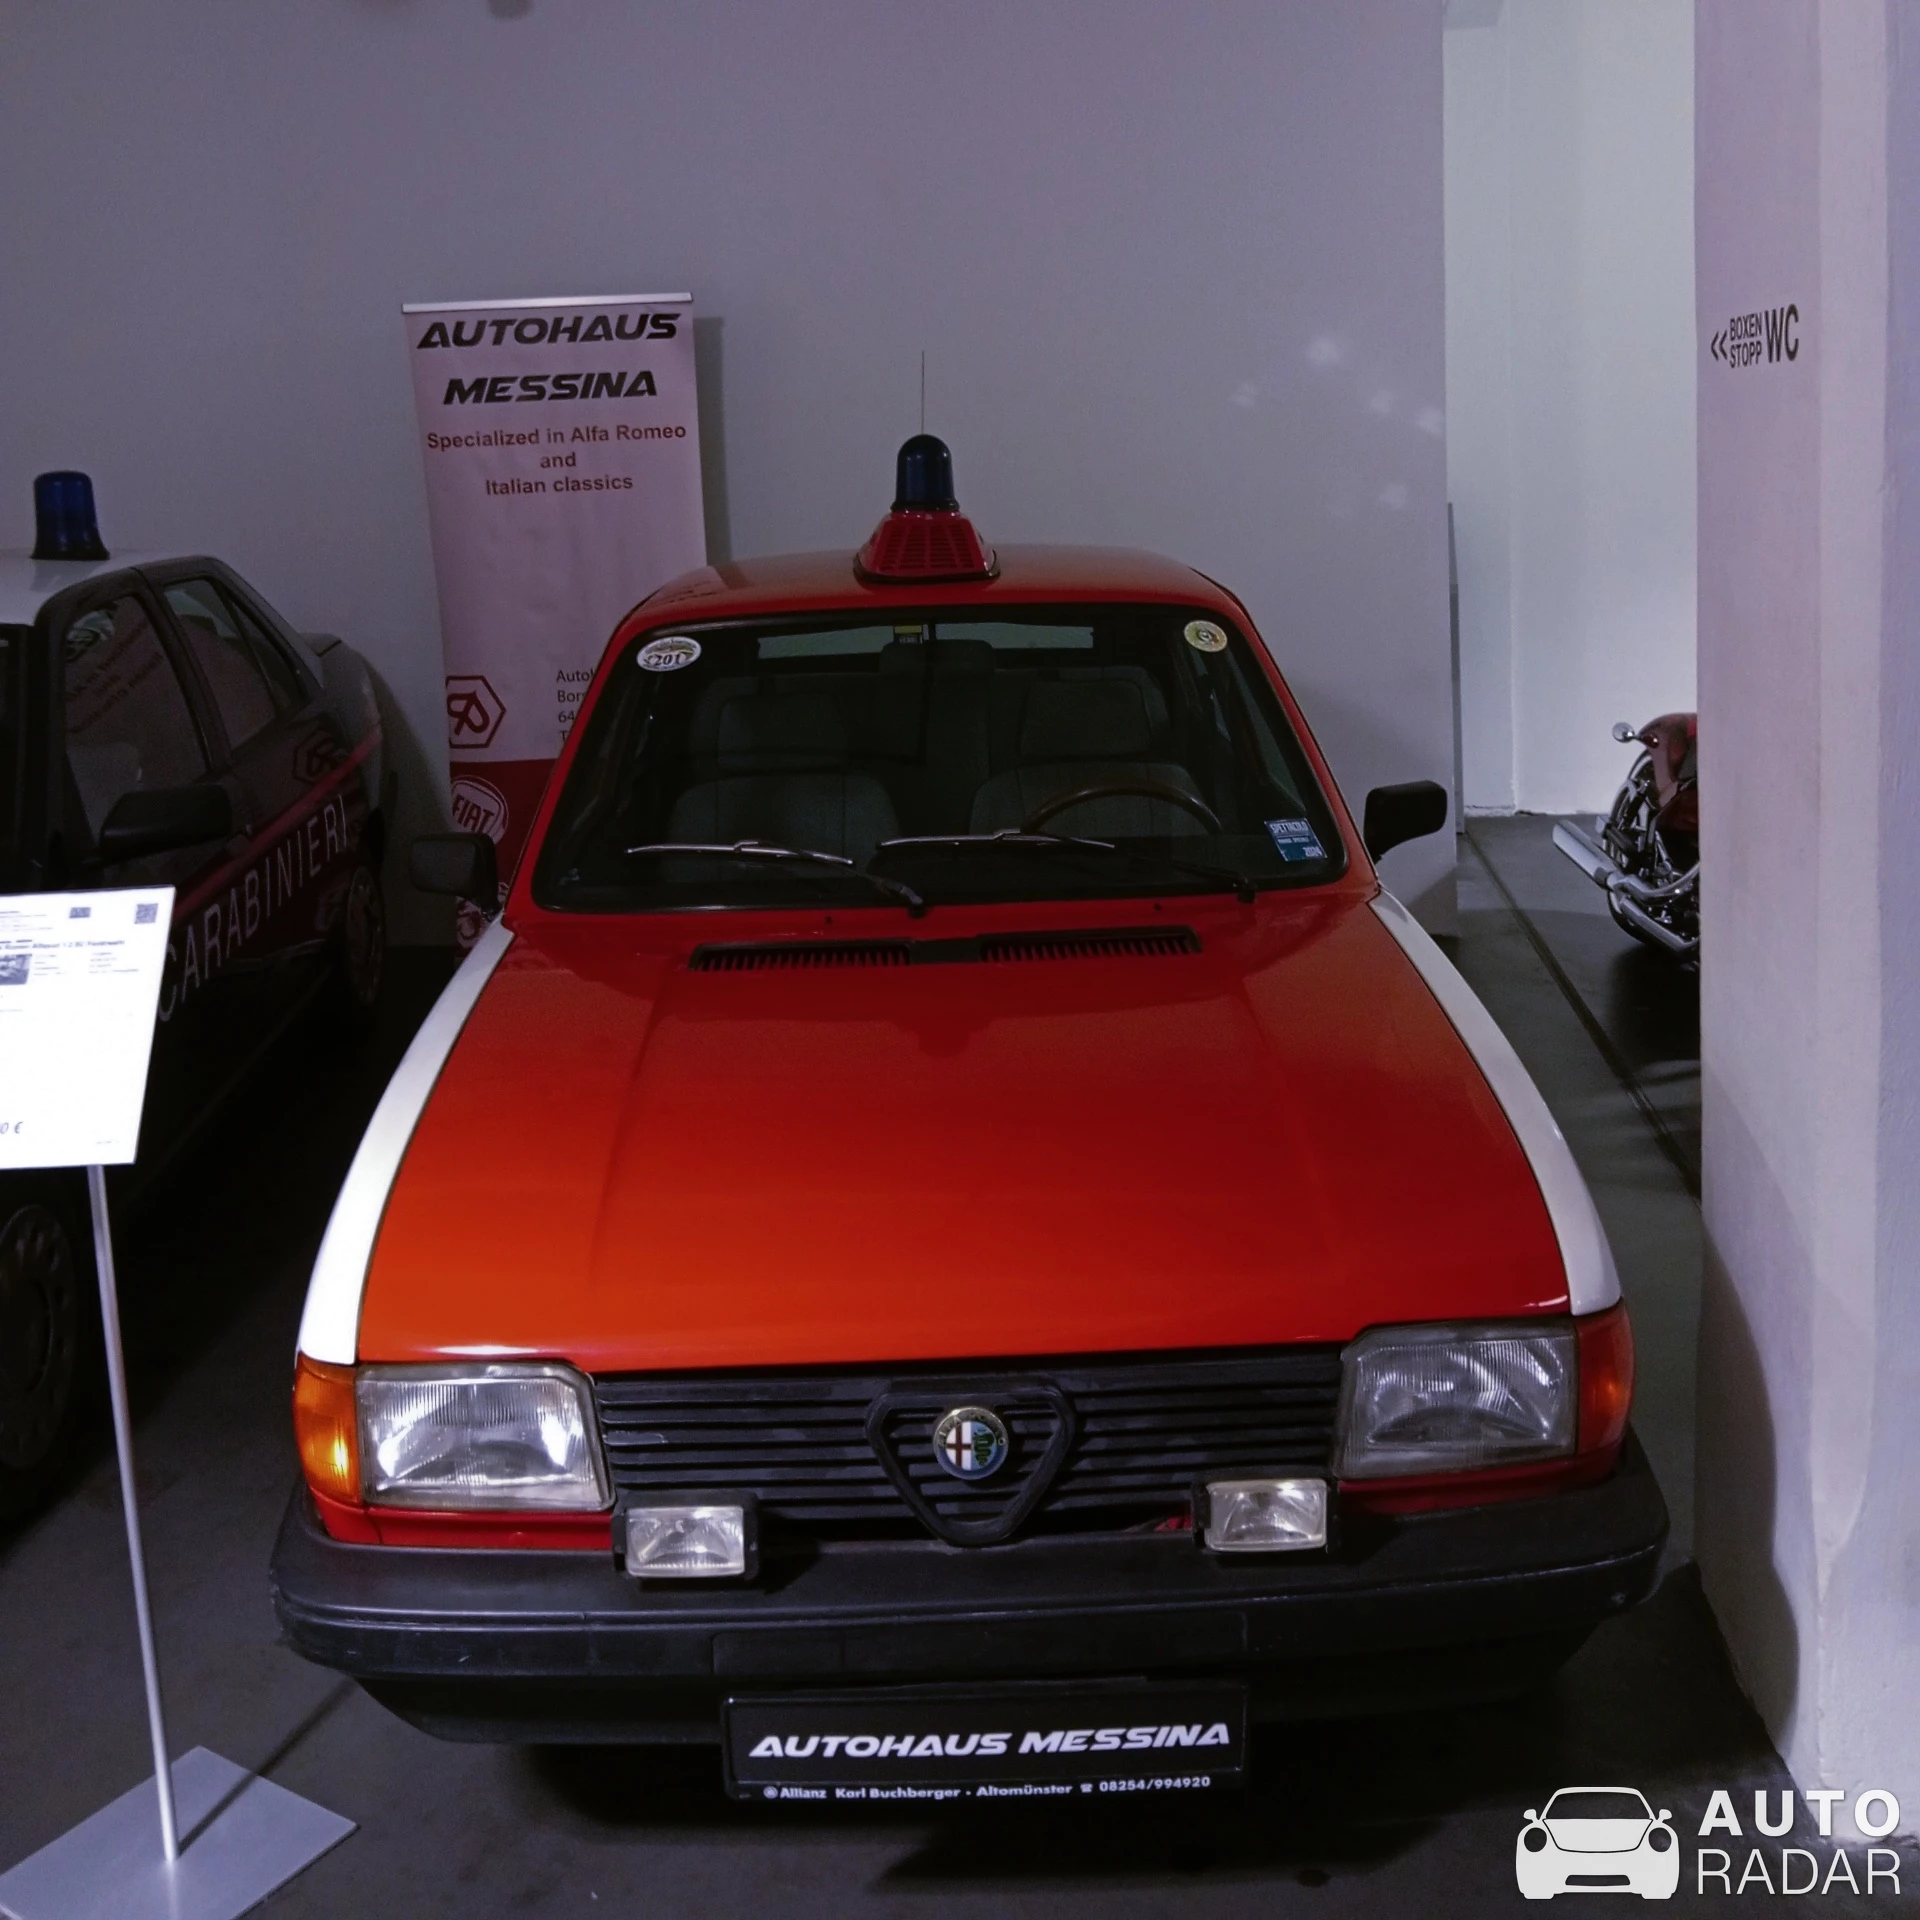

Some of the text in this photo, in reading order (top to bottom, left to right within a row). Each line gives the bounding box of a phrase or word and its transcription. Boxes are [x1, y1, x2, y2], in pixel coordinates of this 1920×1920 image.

[417, 313, 681, 349] AUTOHAUS
[1730, 312, 1762, 341] BOXEN
[1764, 303, 1799, 363] WC
[1730, 340, 1762, 369] STOPP
[443, 371, 657, 405] MESSINA
[427, 425, 687, 452] Specialized in Alfa Romeo
[540, 453, 577, 469] and
[486, 474, 633, 496] Italian classics
[452, 794, 495, 834] FIAT
[158, 794, 348, 1022] CARABINIERI
[749, 1723, 1230, 1758] AUTOHAUS MESSINA
[780, 1776, 1211, 1800] Allianz Karl Buchberger Altomünster 08254/994920
